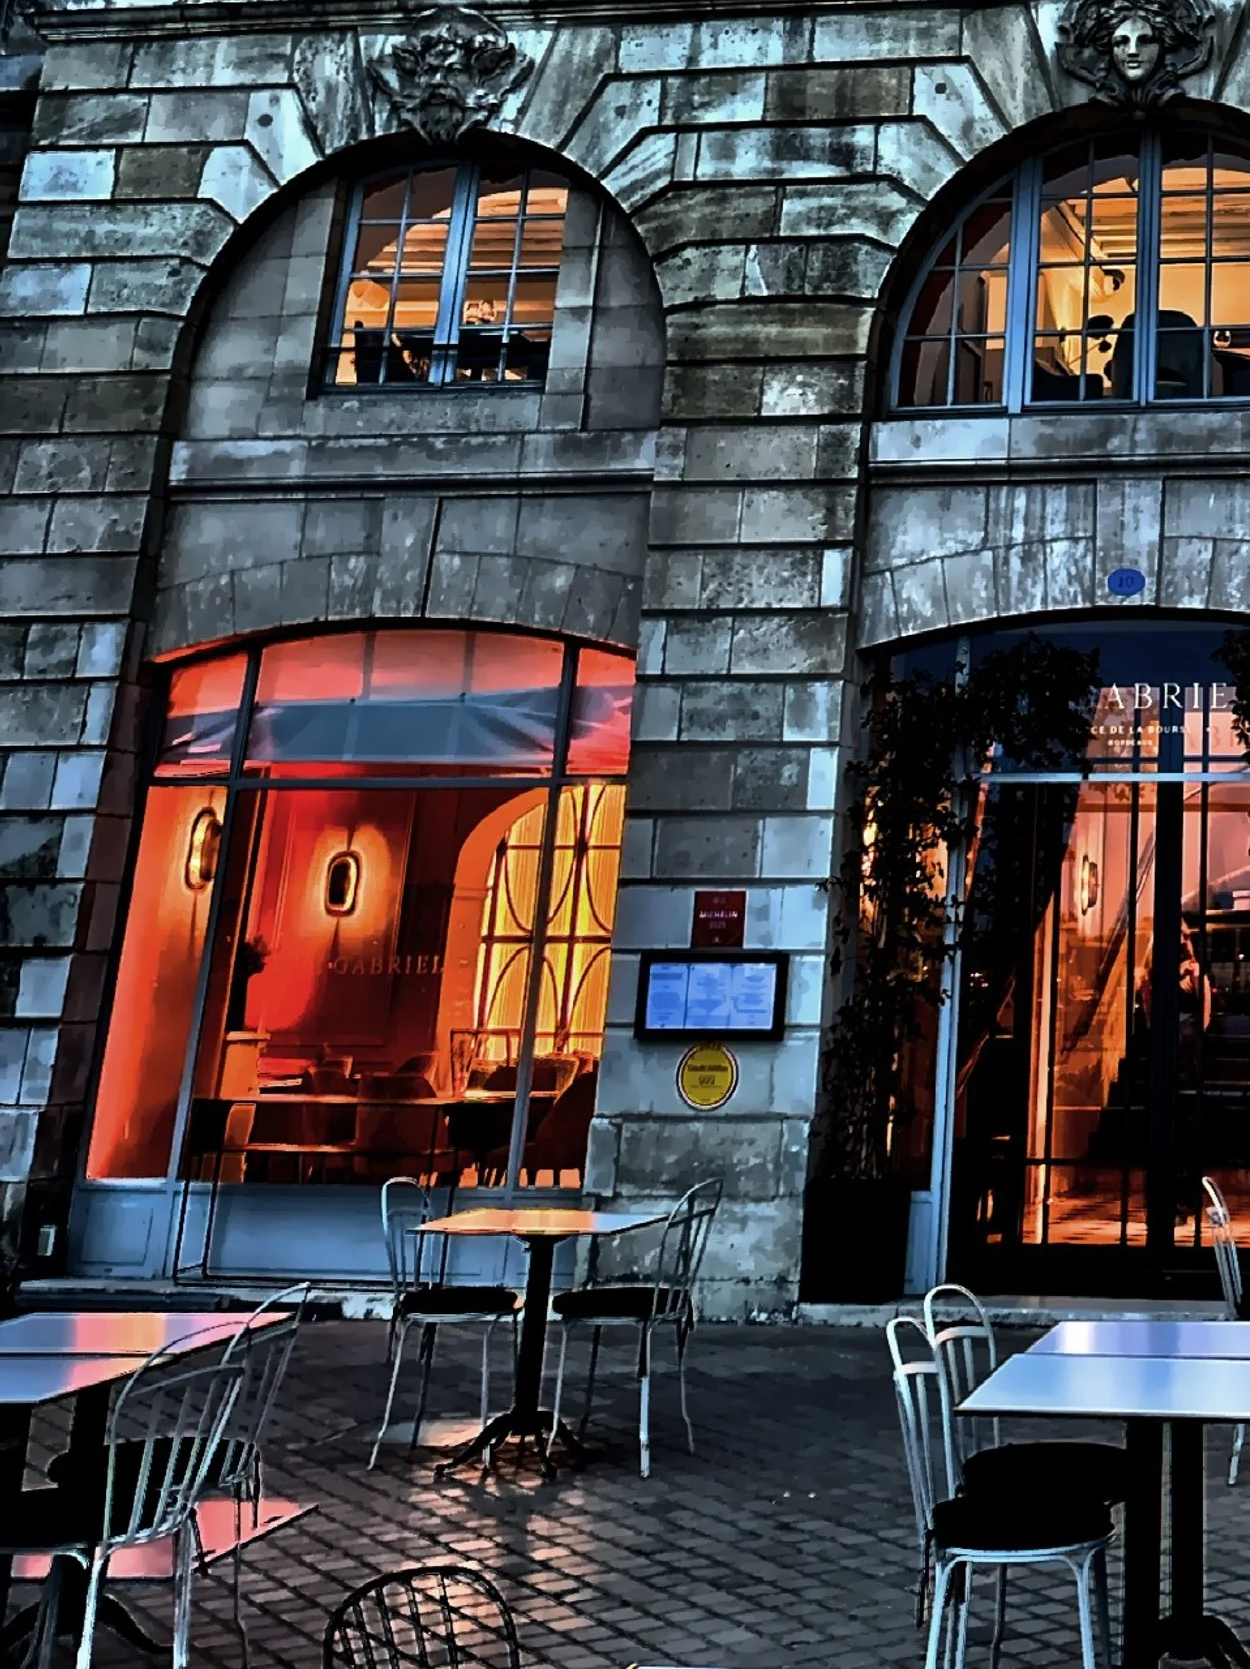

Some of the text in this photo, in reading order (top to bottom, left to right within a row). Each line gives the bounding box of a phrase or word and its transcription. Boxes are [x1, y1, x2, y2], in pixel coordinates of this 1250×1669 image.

[1118, 575, 1135, 588] 10
[1104, 681, 1231, 710] ABRIE
[1109, 725, 1125, 735] DE
[1129, 725, 1144, 735] LA
[1147, 724, 1190, 735] BOURS
[699, 909, 738, 919] MICHELIN
[335, 954, 445, 976] GABRIEL
